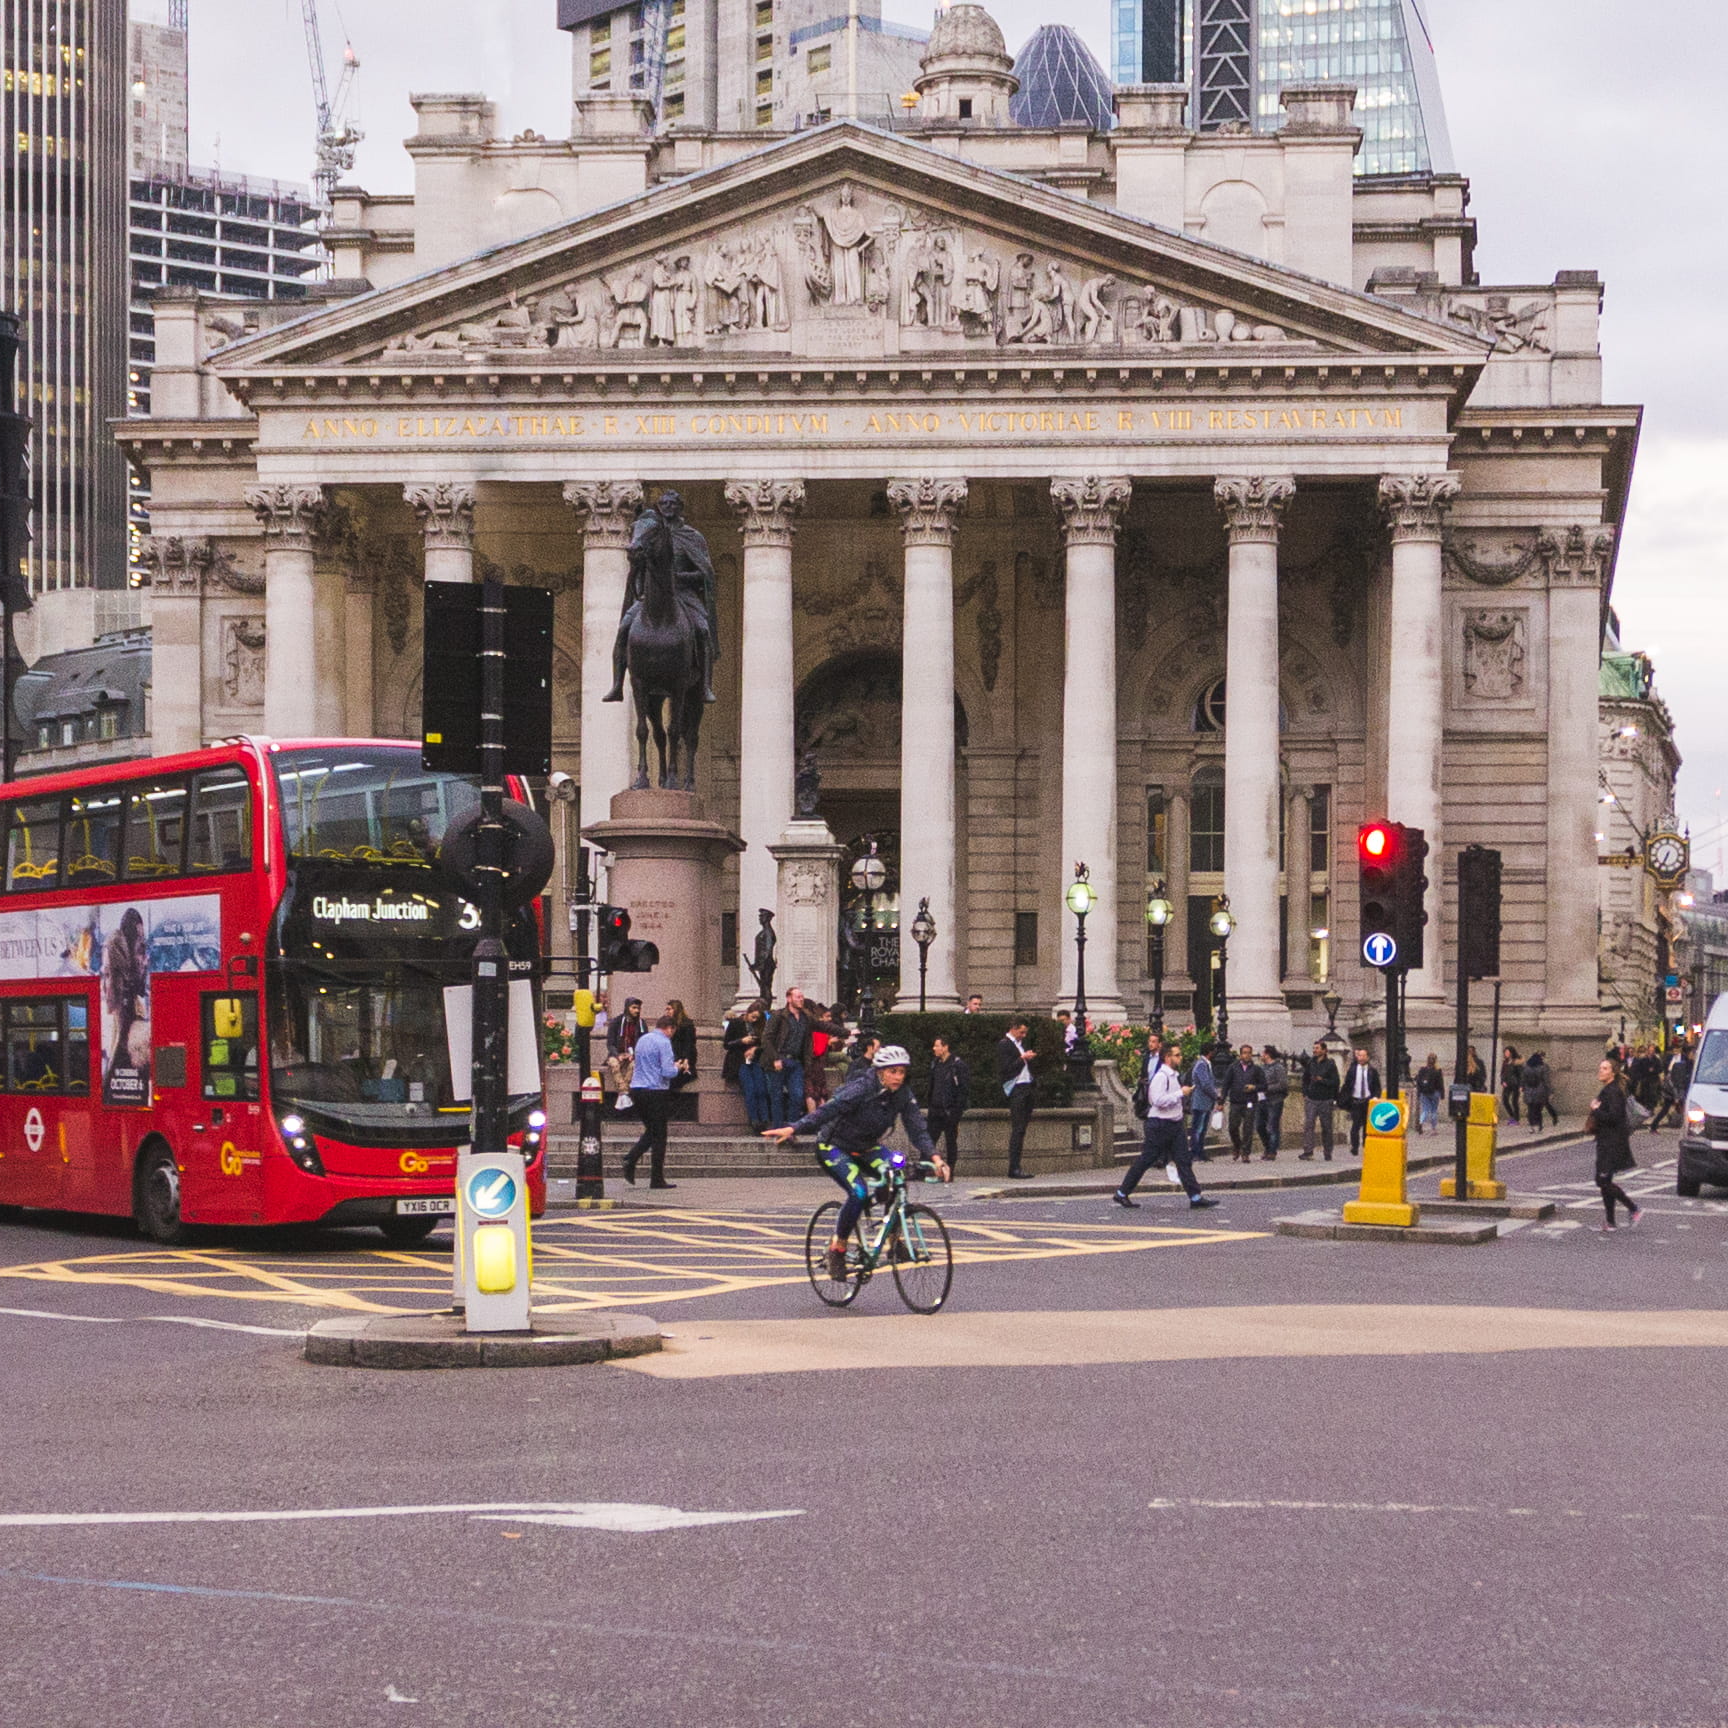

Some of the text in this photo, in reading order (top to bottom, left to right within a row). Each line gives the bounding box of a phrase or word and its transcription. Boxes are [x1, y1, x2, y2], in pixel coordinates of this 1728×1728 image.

[303, 418, 378, 440] ANNO
[690, 414, 829, 435] CONDITVM
[863, 412, 941, 433] ANNO
[958, 411, 1101, 433] VICTORIAE
[1152, 409, 1193, 431] VIII
[1208, 407, 1403, 430] RESTAVRATVM
[313, 896, 429, 925] Clapham Junction
[458, 896, 482, 930] 3
[0, 938, 42, 960] BETWEEN
[509, 960, 532, 971] EH59
[111, 1078, 138, 1090] OCTOBER
[403, 1201, 427, 1212] YX16
